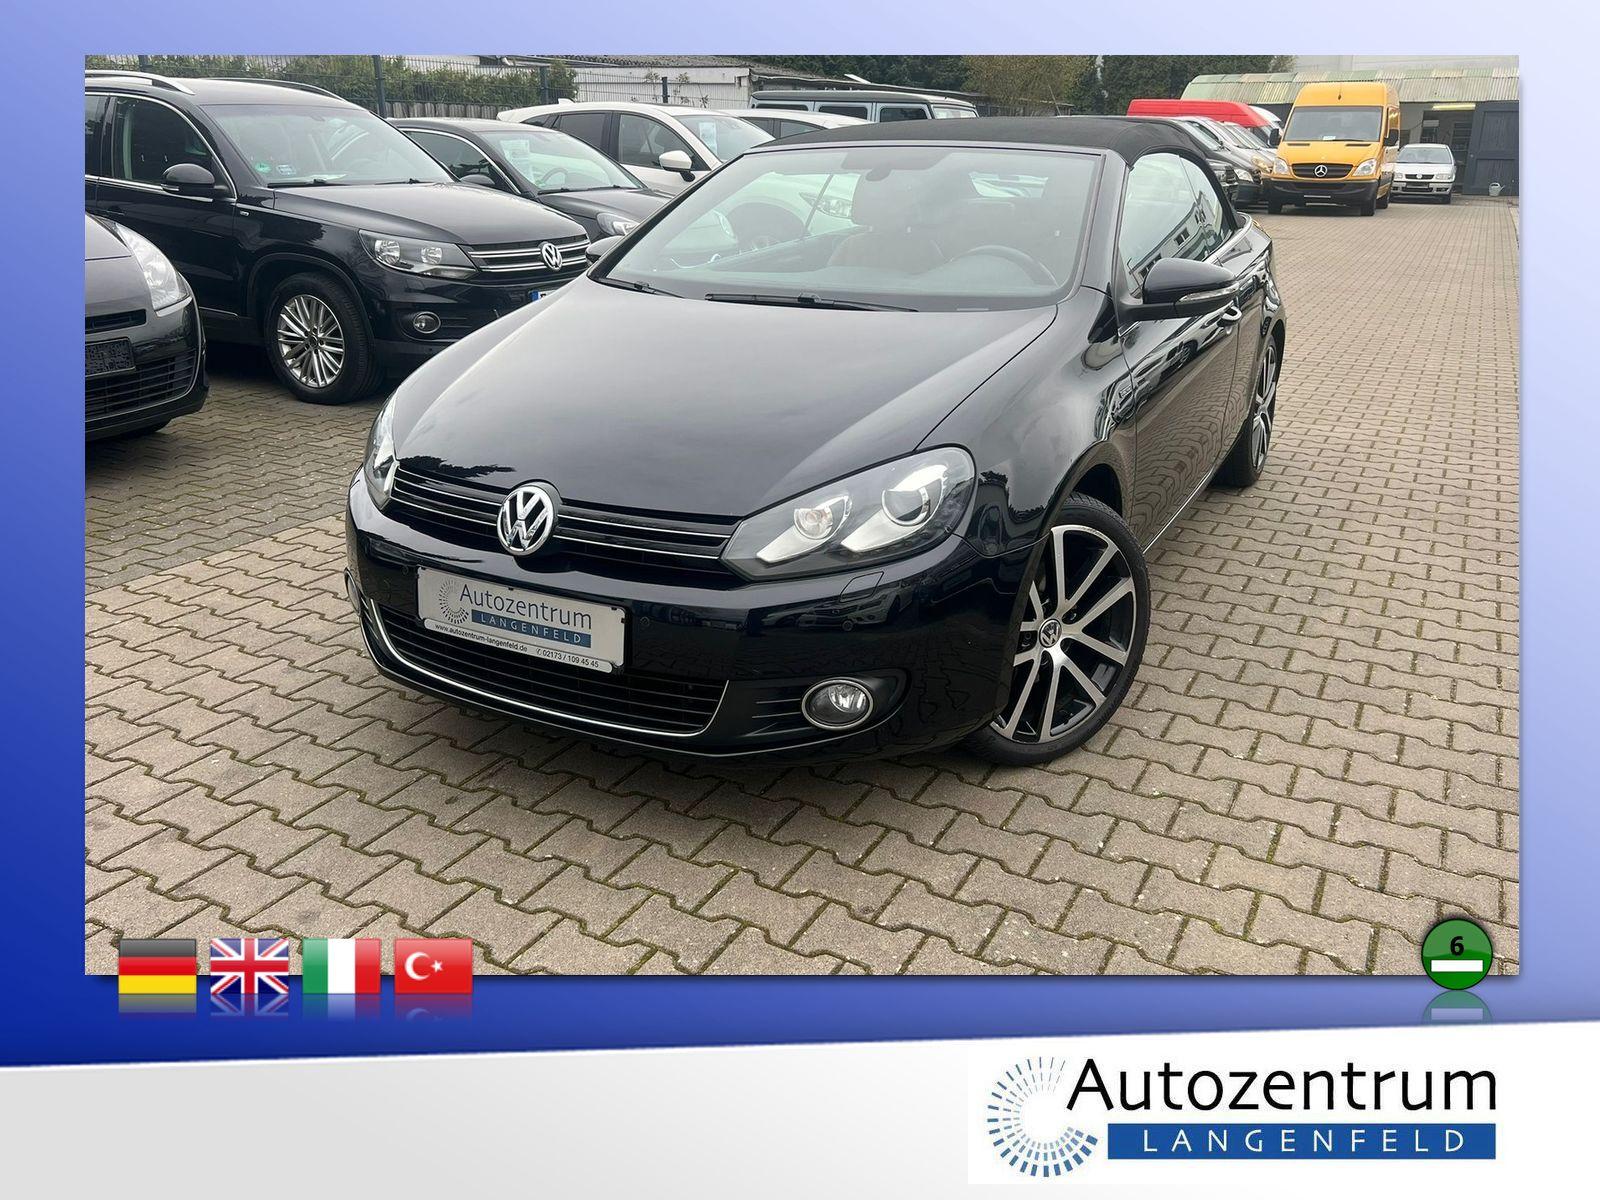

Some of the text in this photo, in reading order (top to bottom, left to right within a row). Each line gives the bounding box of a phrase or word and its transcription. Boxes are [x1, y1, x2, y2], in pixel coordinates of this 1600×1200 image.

[498, 486, 553, 554] VW
[460, 584, 592, 629] Autozentrum
[434, 623, 528, 652] www.autozentrum-langenfeld.de
[481, 613, 582, 643] LANGENFELD
[542, 649, 562, 660] 02173
[568, 655, 580, 664] 109
[580, 658, 590, 666] 45
[590, 660, 599, 668] 45
